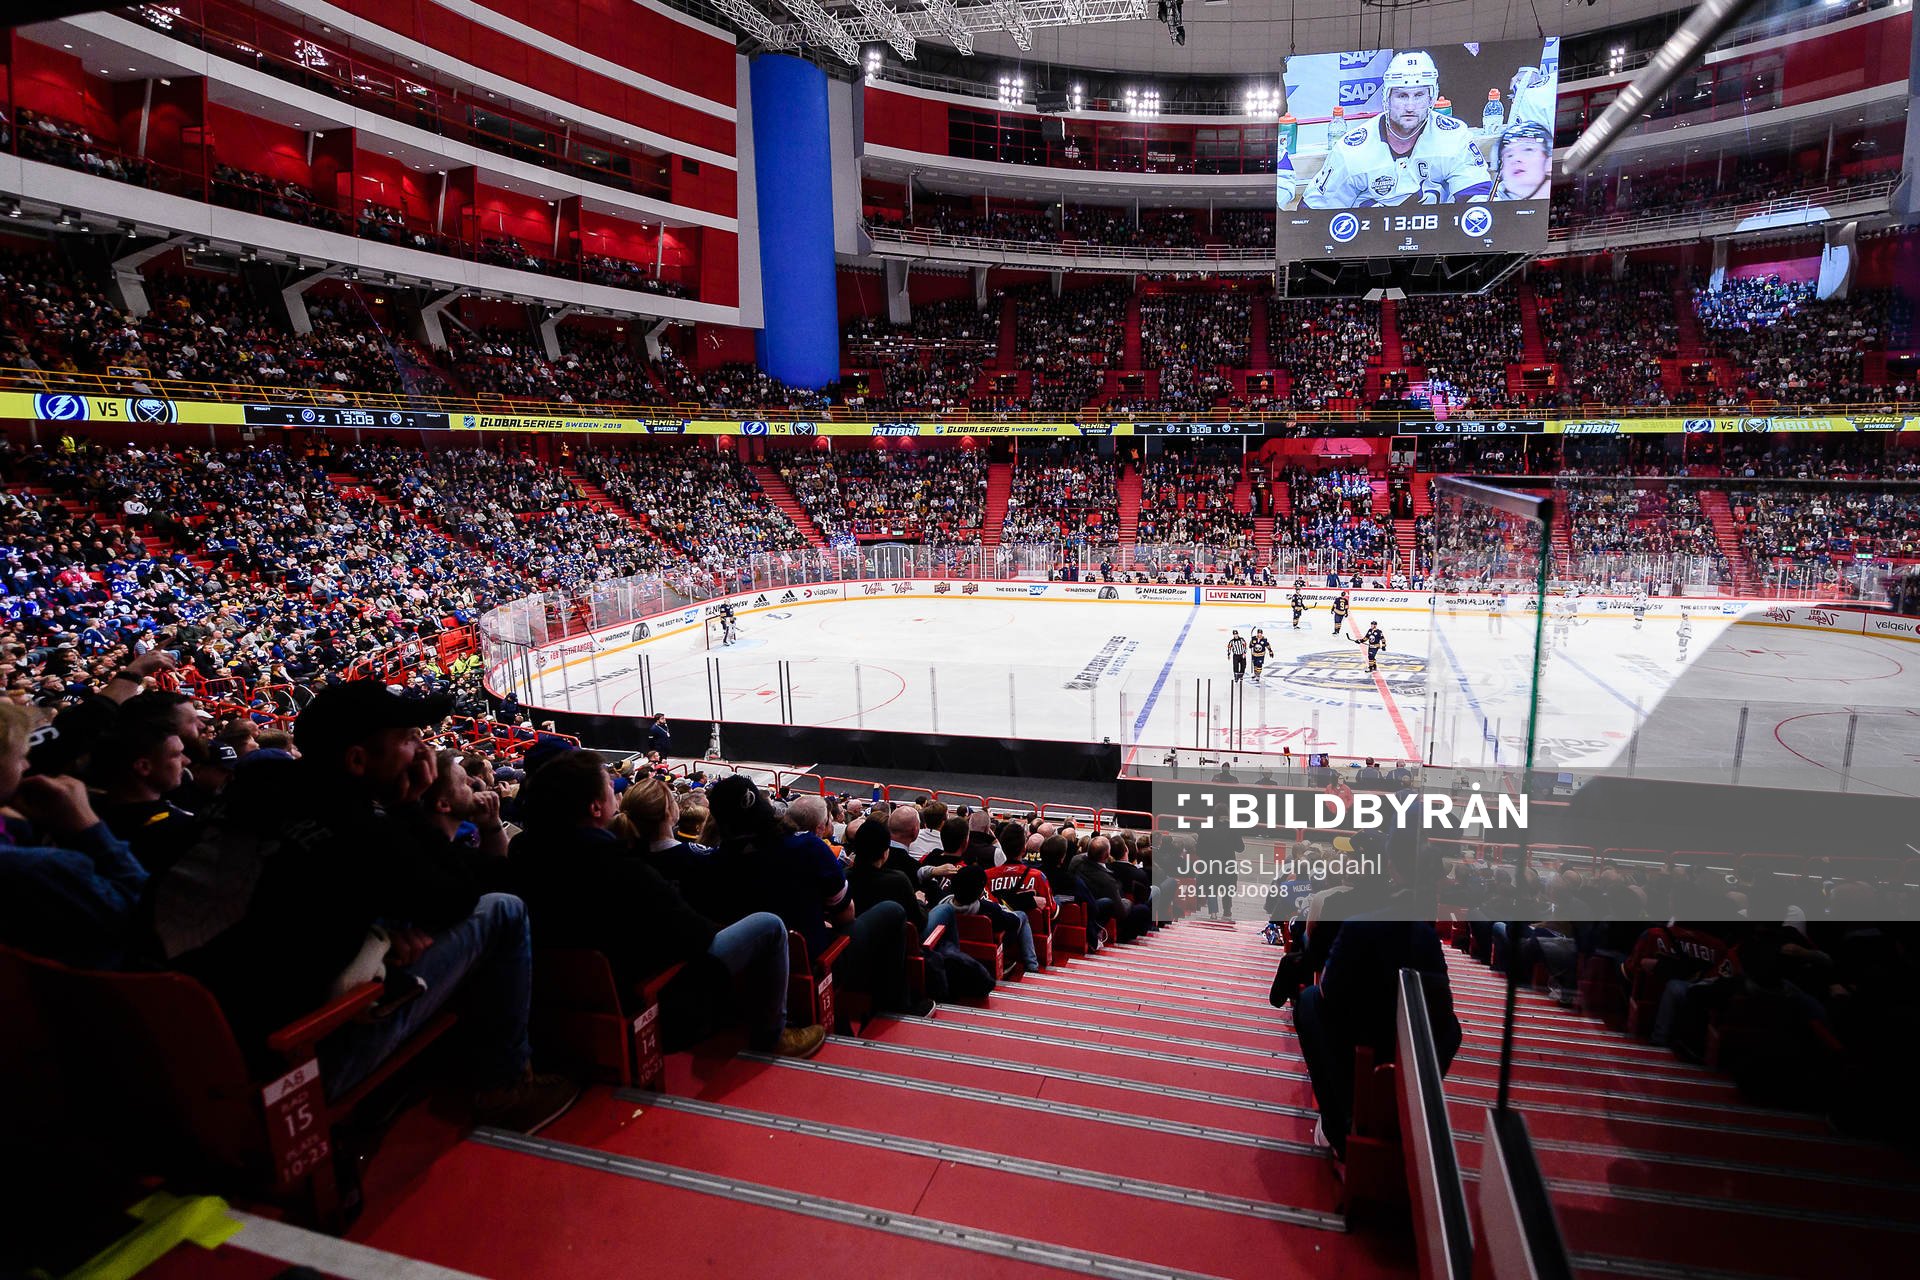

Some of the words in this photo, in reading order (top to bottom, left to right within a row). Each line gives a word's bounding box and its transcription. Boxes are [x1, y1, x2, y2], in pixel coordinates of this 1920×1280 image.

[1340, 83, 1377, 102] SAP
[1418, 162, 1428, 178] C
[1361, 220, 1370, 230] 2
[1383, 215, 1439, 231] 13:08
[1453, 216, 1459, 226] 1
[1405, 237, 1413, 245] 3
[97, 402, 118, 417] VS
[318, 415, 326, 423] 2
[335, 414, 375, 425] 13:08
[383, 417, 388, 425] 1
[774, 425, 786, 433] VS
[1457, 425, 1486, 433] 13:08
[1720, 421, 1733, 430] VS
[813, 588, 838, 597] viaplay
[1029, 586, 1046, 594] SAP
[991, 876, 1035, 892] IGINA
[285, 1103, 313, 1137] 15
